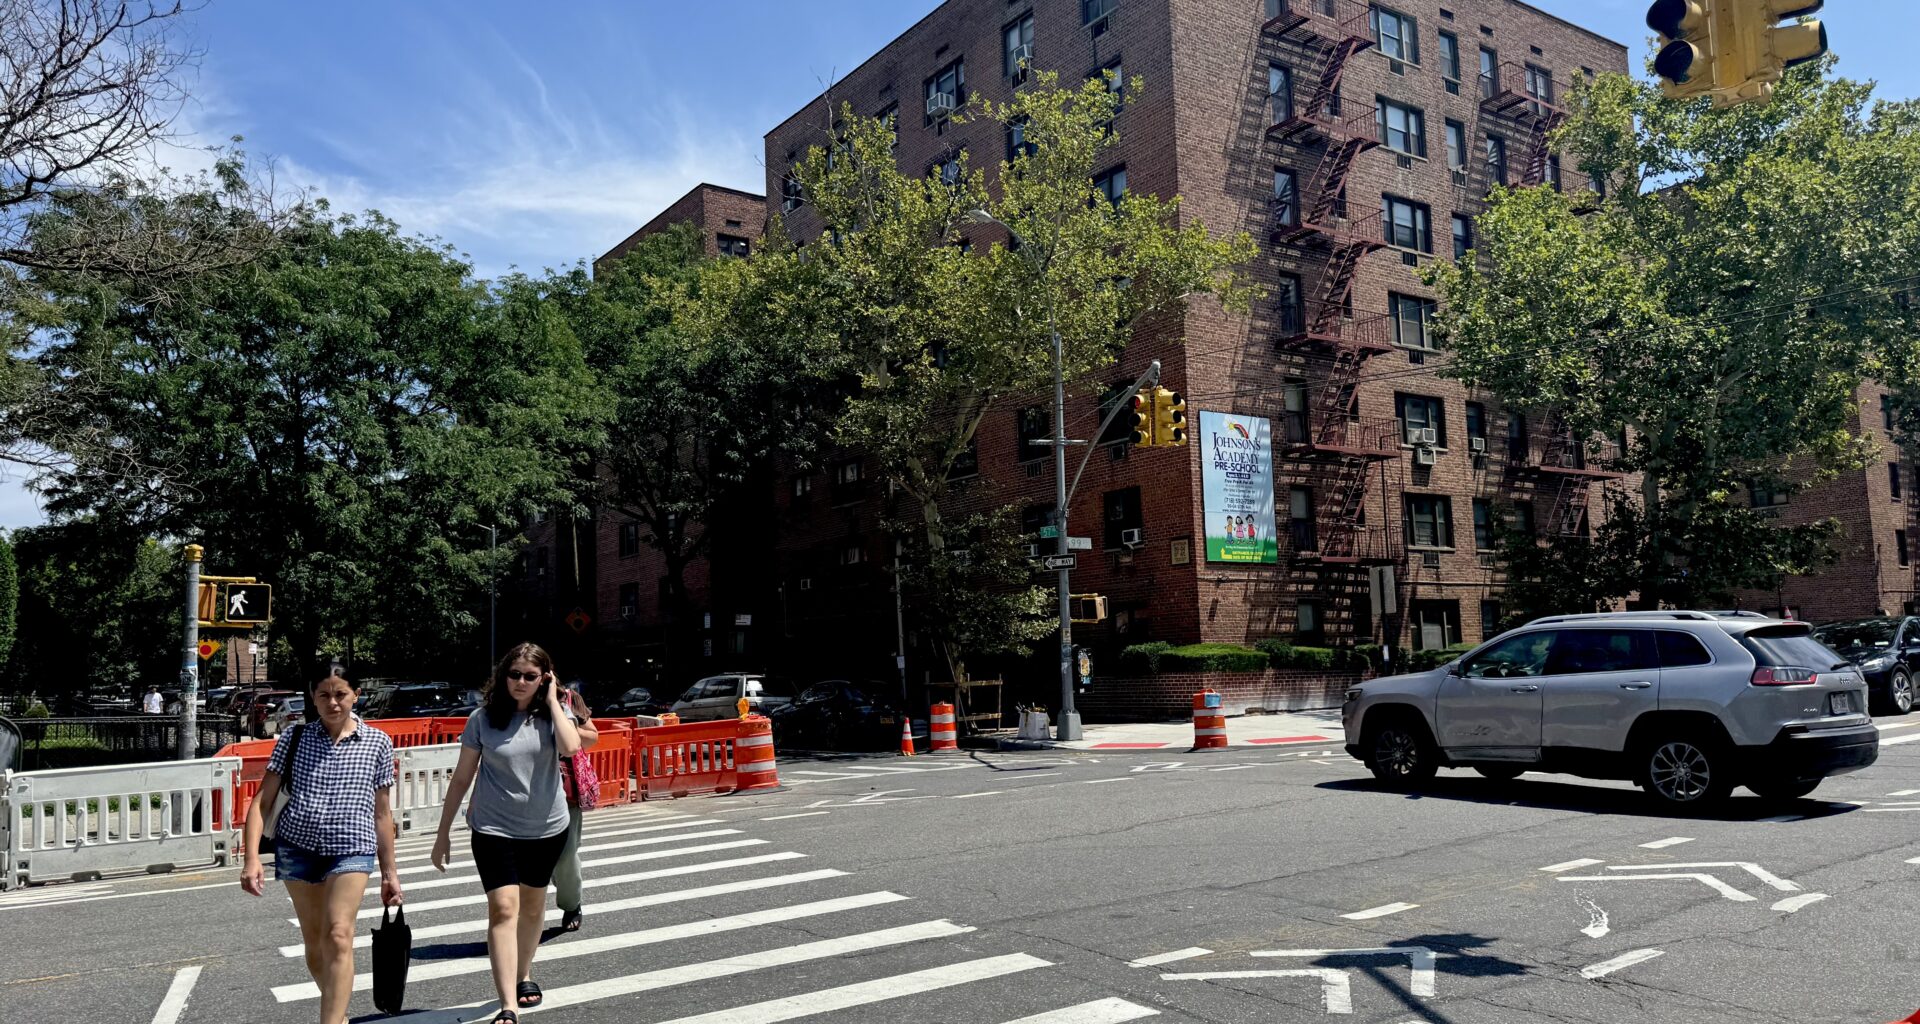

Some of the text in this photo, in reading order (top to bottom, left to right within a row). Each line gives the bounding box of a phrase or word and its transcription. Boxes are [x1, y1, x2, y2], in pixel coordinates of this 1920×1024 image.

[1212, 432, 1261, 451] JOHNSON'S
[1213, 447, 1260, 464] ACADEMY
[1214, 461, 1261, 474] PRE-SCHOOL
[1070, 538, 1082, 547] 99
